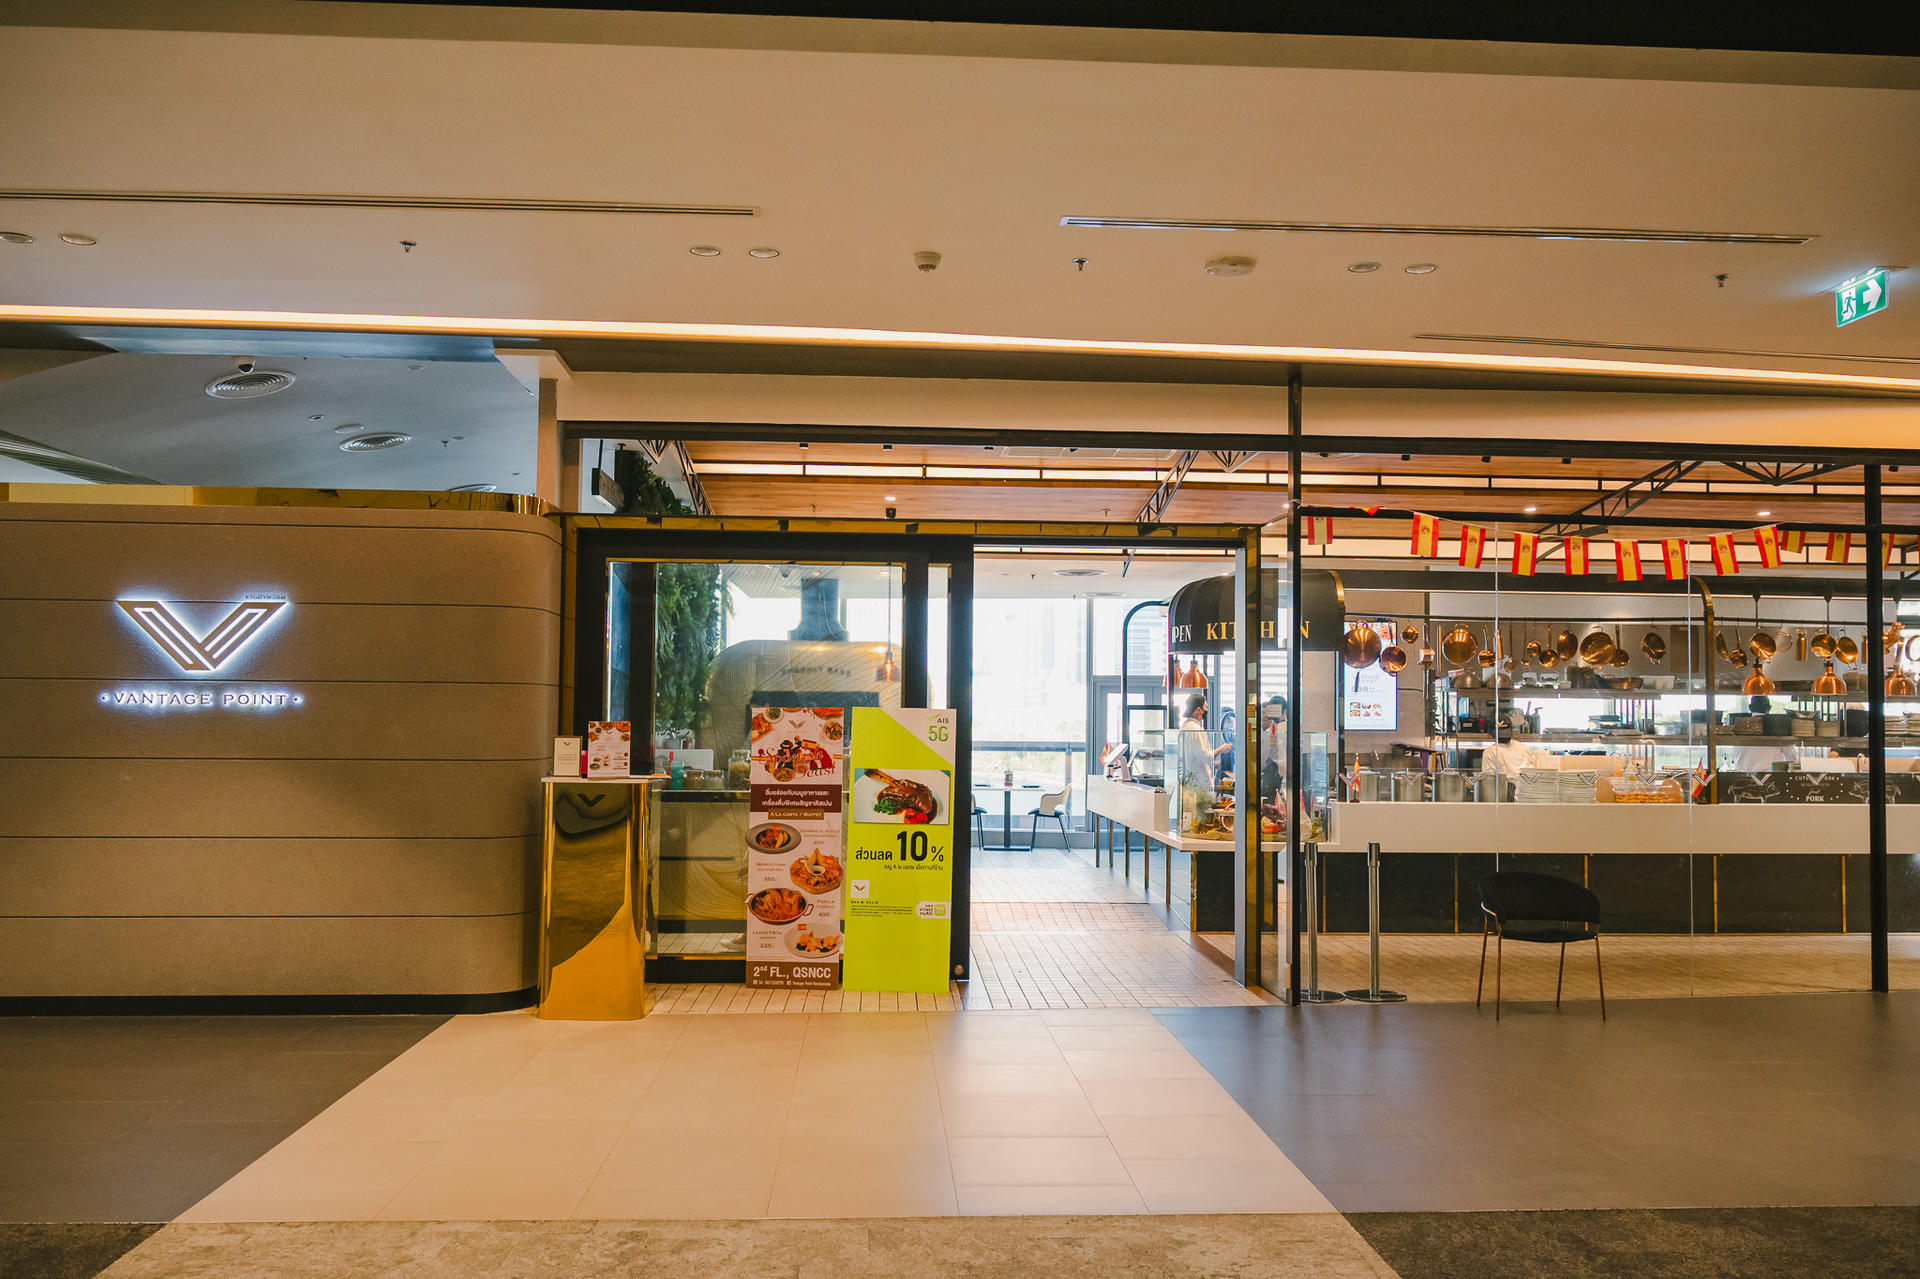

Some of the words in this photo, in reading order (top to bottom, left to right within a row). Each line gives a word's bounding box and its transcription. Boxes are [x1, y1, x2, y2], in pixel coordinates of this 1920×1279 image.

[1206, 620, 1311, 641] KITHN
[113, 692, 211, 705] VANTAGE
[223, 694, 288, 706] POINT
[928, 725, 949, 742] 5G
[855, 846, 893, 861] ส่วนลด
[753, 965, 768, 977] 2nd
[769, 966, 790, 979] FL.,
[792, 966, 832, 979] QSNCC
